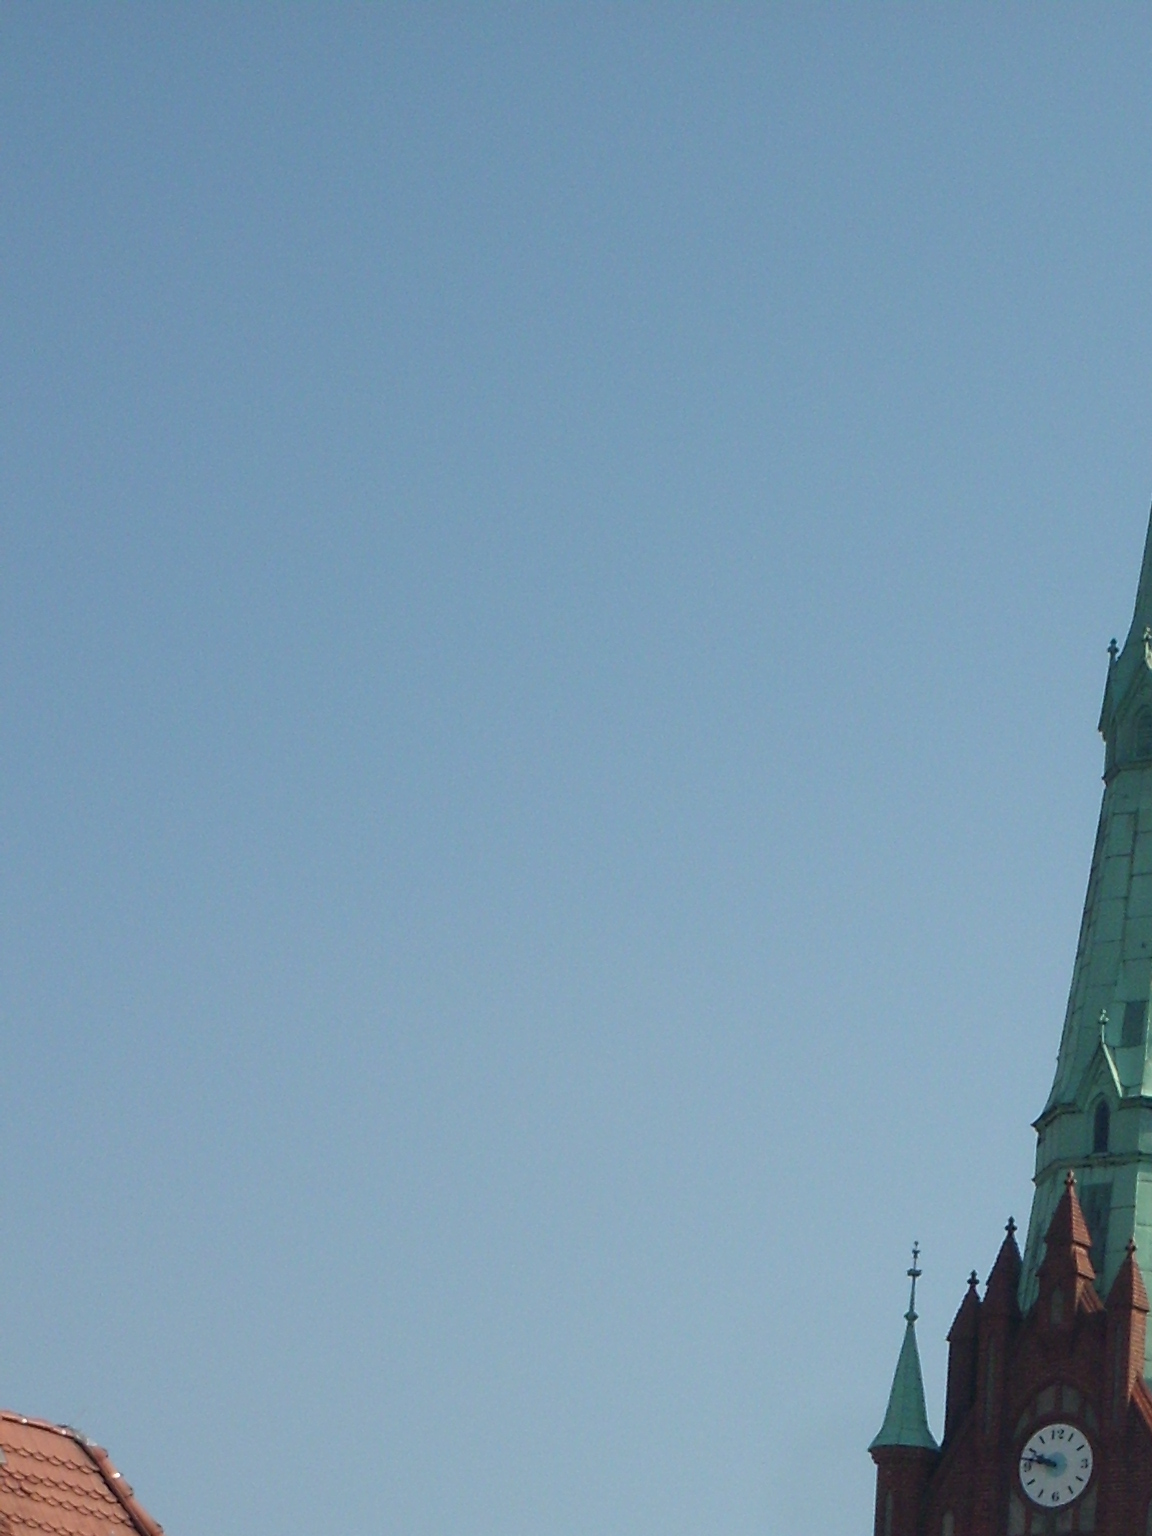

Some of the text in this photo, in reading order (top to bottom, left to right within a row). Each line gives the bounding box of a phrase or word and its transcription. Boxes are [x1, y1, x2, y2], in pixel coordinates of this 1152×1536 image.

[1051, 1428, 1065, 1440] 12
[1080, 1458, 1088, 1469] 3
[1051, 1490, 1060, 1502] 6
